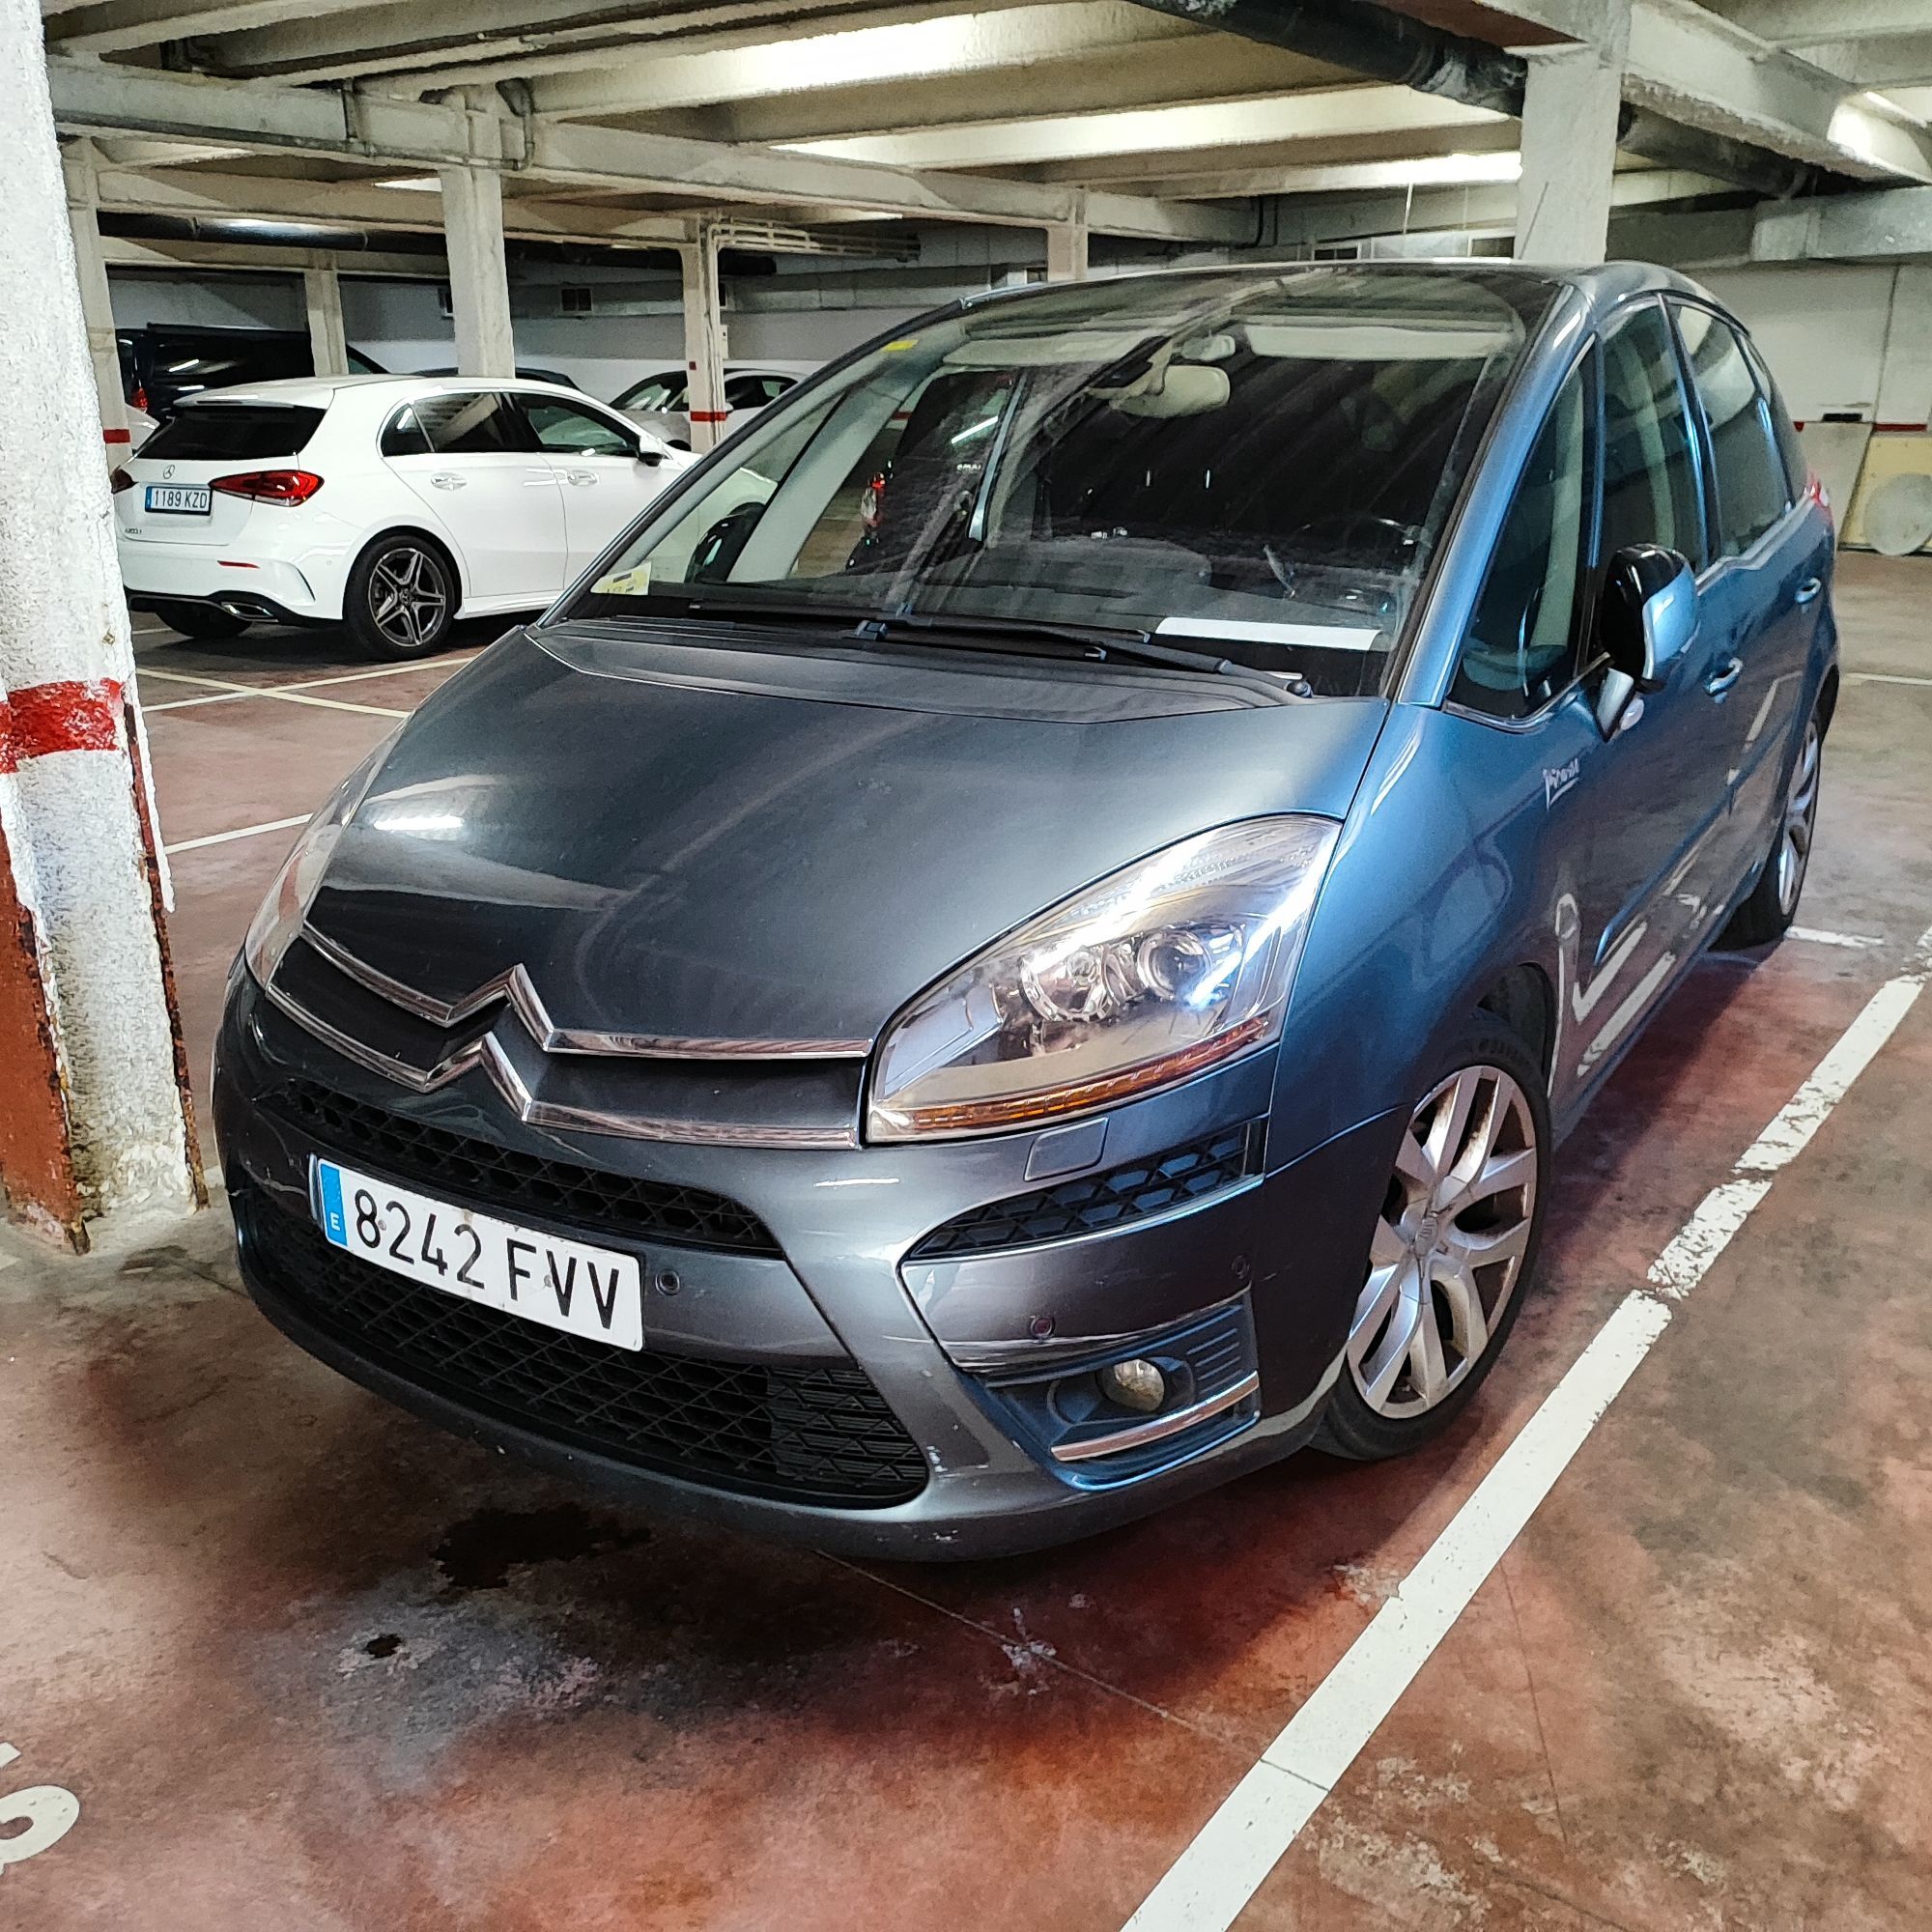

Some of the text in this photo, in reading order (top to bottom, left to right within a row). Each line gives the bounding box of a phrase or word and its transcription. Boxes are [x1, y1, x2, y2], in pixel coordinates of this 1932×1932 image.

[155, 489, 182, 507] 1189
[185, 491, 208, 509] KZD
[329, 1188, 620, 1330] E 8242 FVV
